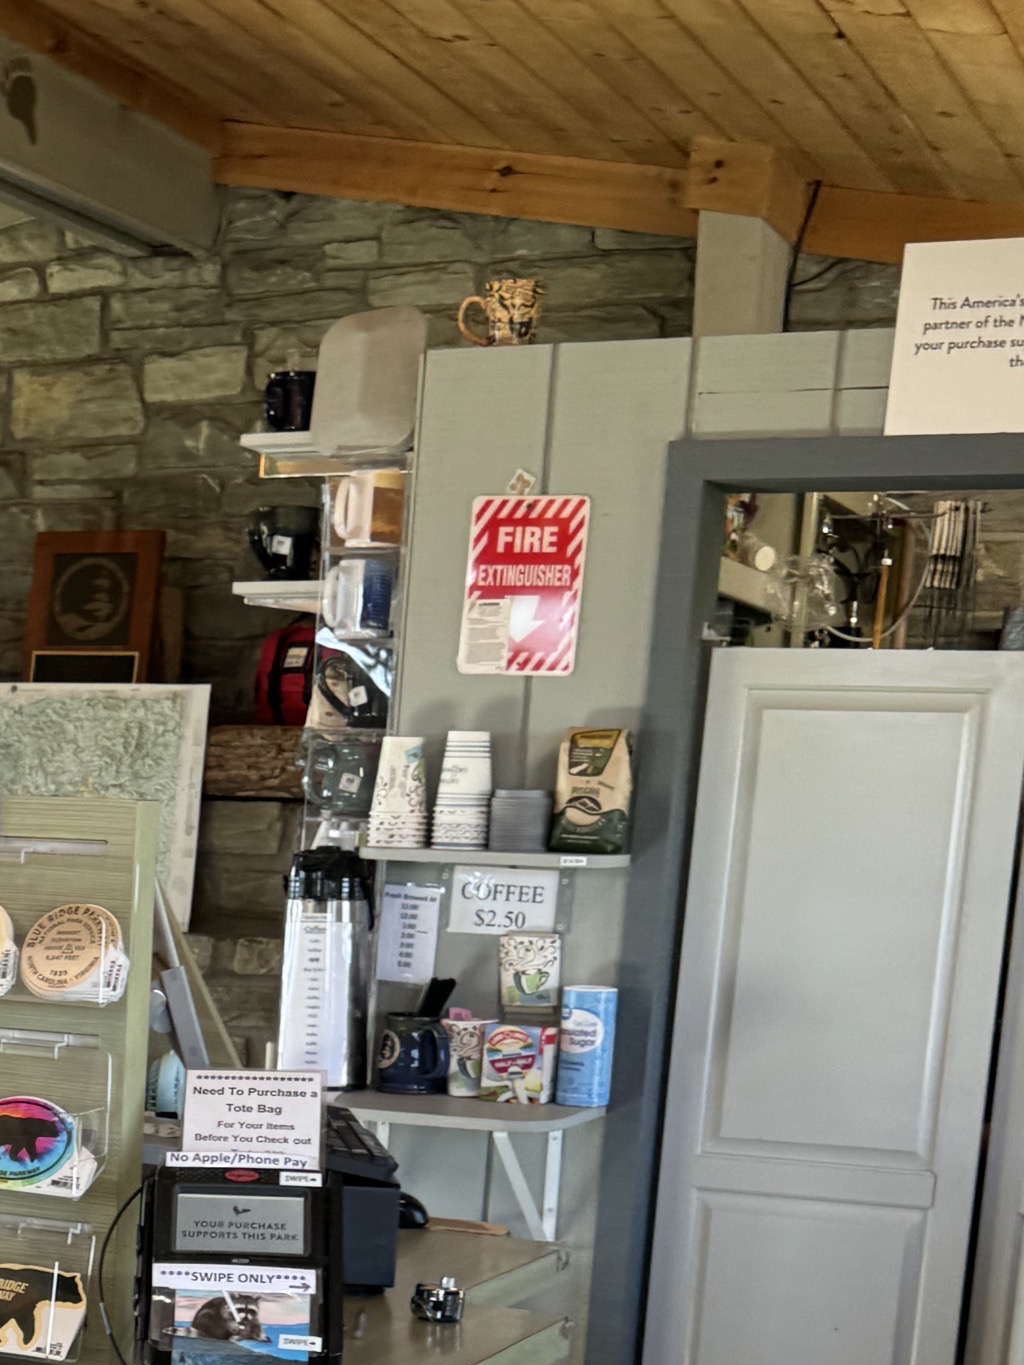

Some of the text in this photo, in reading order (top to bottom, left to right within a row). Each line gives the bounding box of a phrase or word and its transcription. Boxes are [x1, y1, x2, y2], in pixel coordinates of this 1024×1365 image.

[931, 297, 957, 310] This
[923, 320, 972, 335] partner
[975, 316, 990, 329] of
[993, 315, 1015, 328] the
[914, 340, 944, 356] your
[947, 336, 1006, 354] purchase
[496, 526, 559, 553] FIRE
[477, 564, 572, 587] EXTINGUISHER
[461, 880, 545, 904] COFFEE
[474, 909, 526, 929] $2.50
[192, 1086, 225, 1096] Need
[228, 1087, 244, 1096] To
[248, 1088, 307, 1098] Purchase
[226, 1103, 282, 1115] Tote Bag
[217, 1121, 296, 1131] For Your Items
[194, 1133, 312, 1145] Before You Check out
[170, 1152, 308, 1168] No Apple/Phone Pay
[193, 1220, 287, 1231] YOUR PURCHASE
[182, 1231, 298, 1241] SUPPORTS THIS PARK
[191, 1271, 275, 1284] SWIPE ONLY
